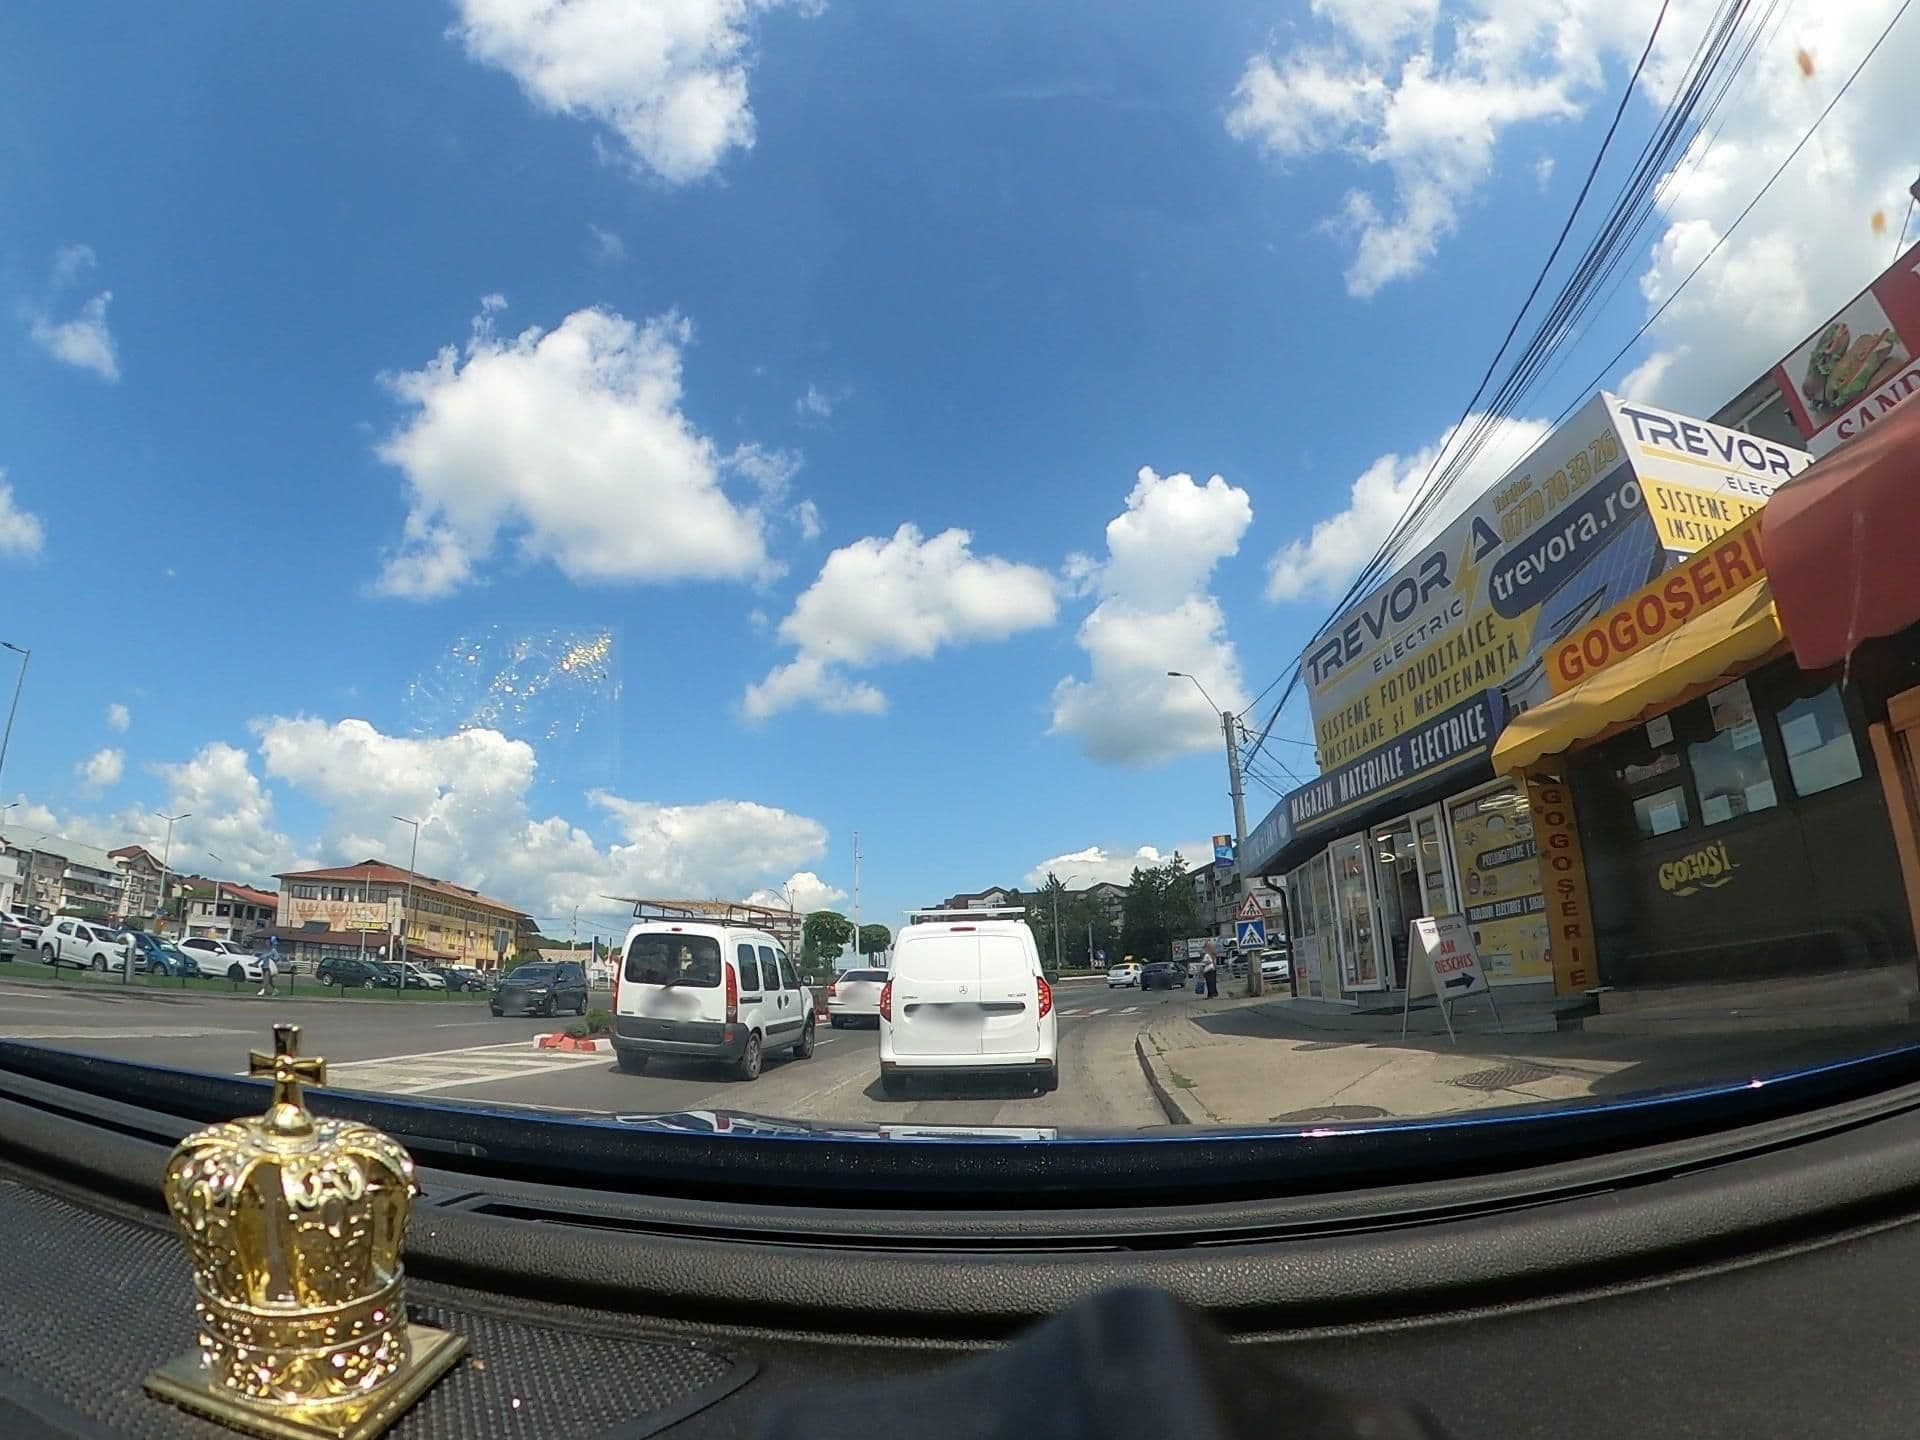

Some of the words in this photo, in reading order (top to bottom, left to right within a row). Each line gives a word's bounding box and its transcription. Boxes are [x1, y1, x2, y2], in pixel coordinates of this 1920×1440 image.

[1566, 450, 1592, 493] 33
[1656, 487, 1731, 522] SISTEME
[1492, 480, 1642, 601] trevora.ro
[1372, 599, 1464, 674] ELECTRIC
[1321, 695, 1372, 744] SISTEME
[1380, 612, 1496, 706] FOTOVOLTAICE
[1322, 718, 1384, 768] INSTALARE
[1413, 632, 1519, 718] MENTENANȚĂ
[1291, 780, 1334, 824] MAGAZIN
[1339, 745, 1405, 802] MATERIALE
[1410, 703, 1488, 771] ELECTRICE
[1434, 953, 1474, 975] DESCHIS
[1440, 939, 1456, 956] AM
